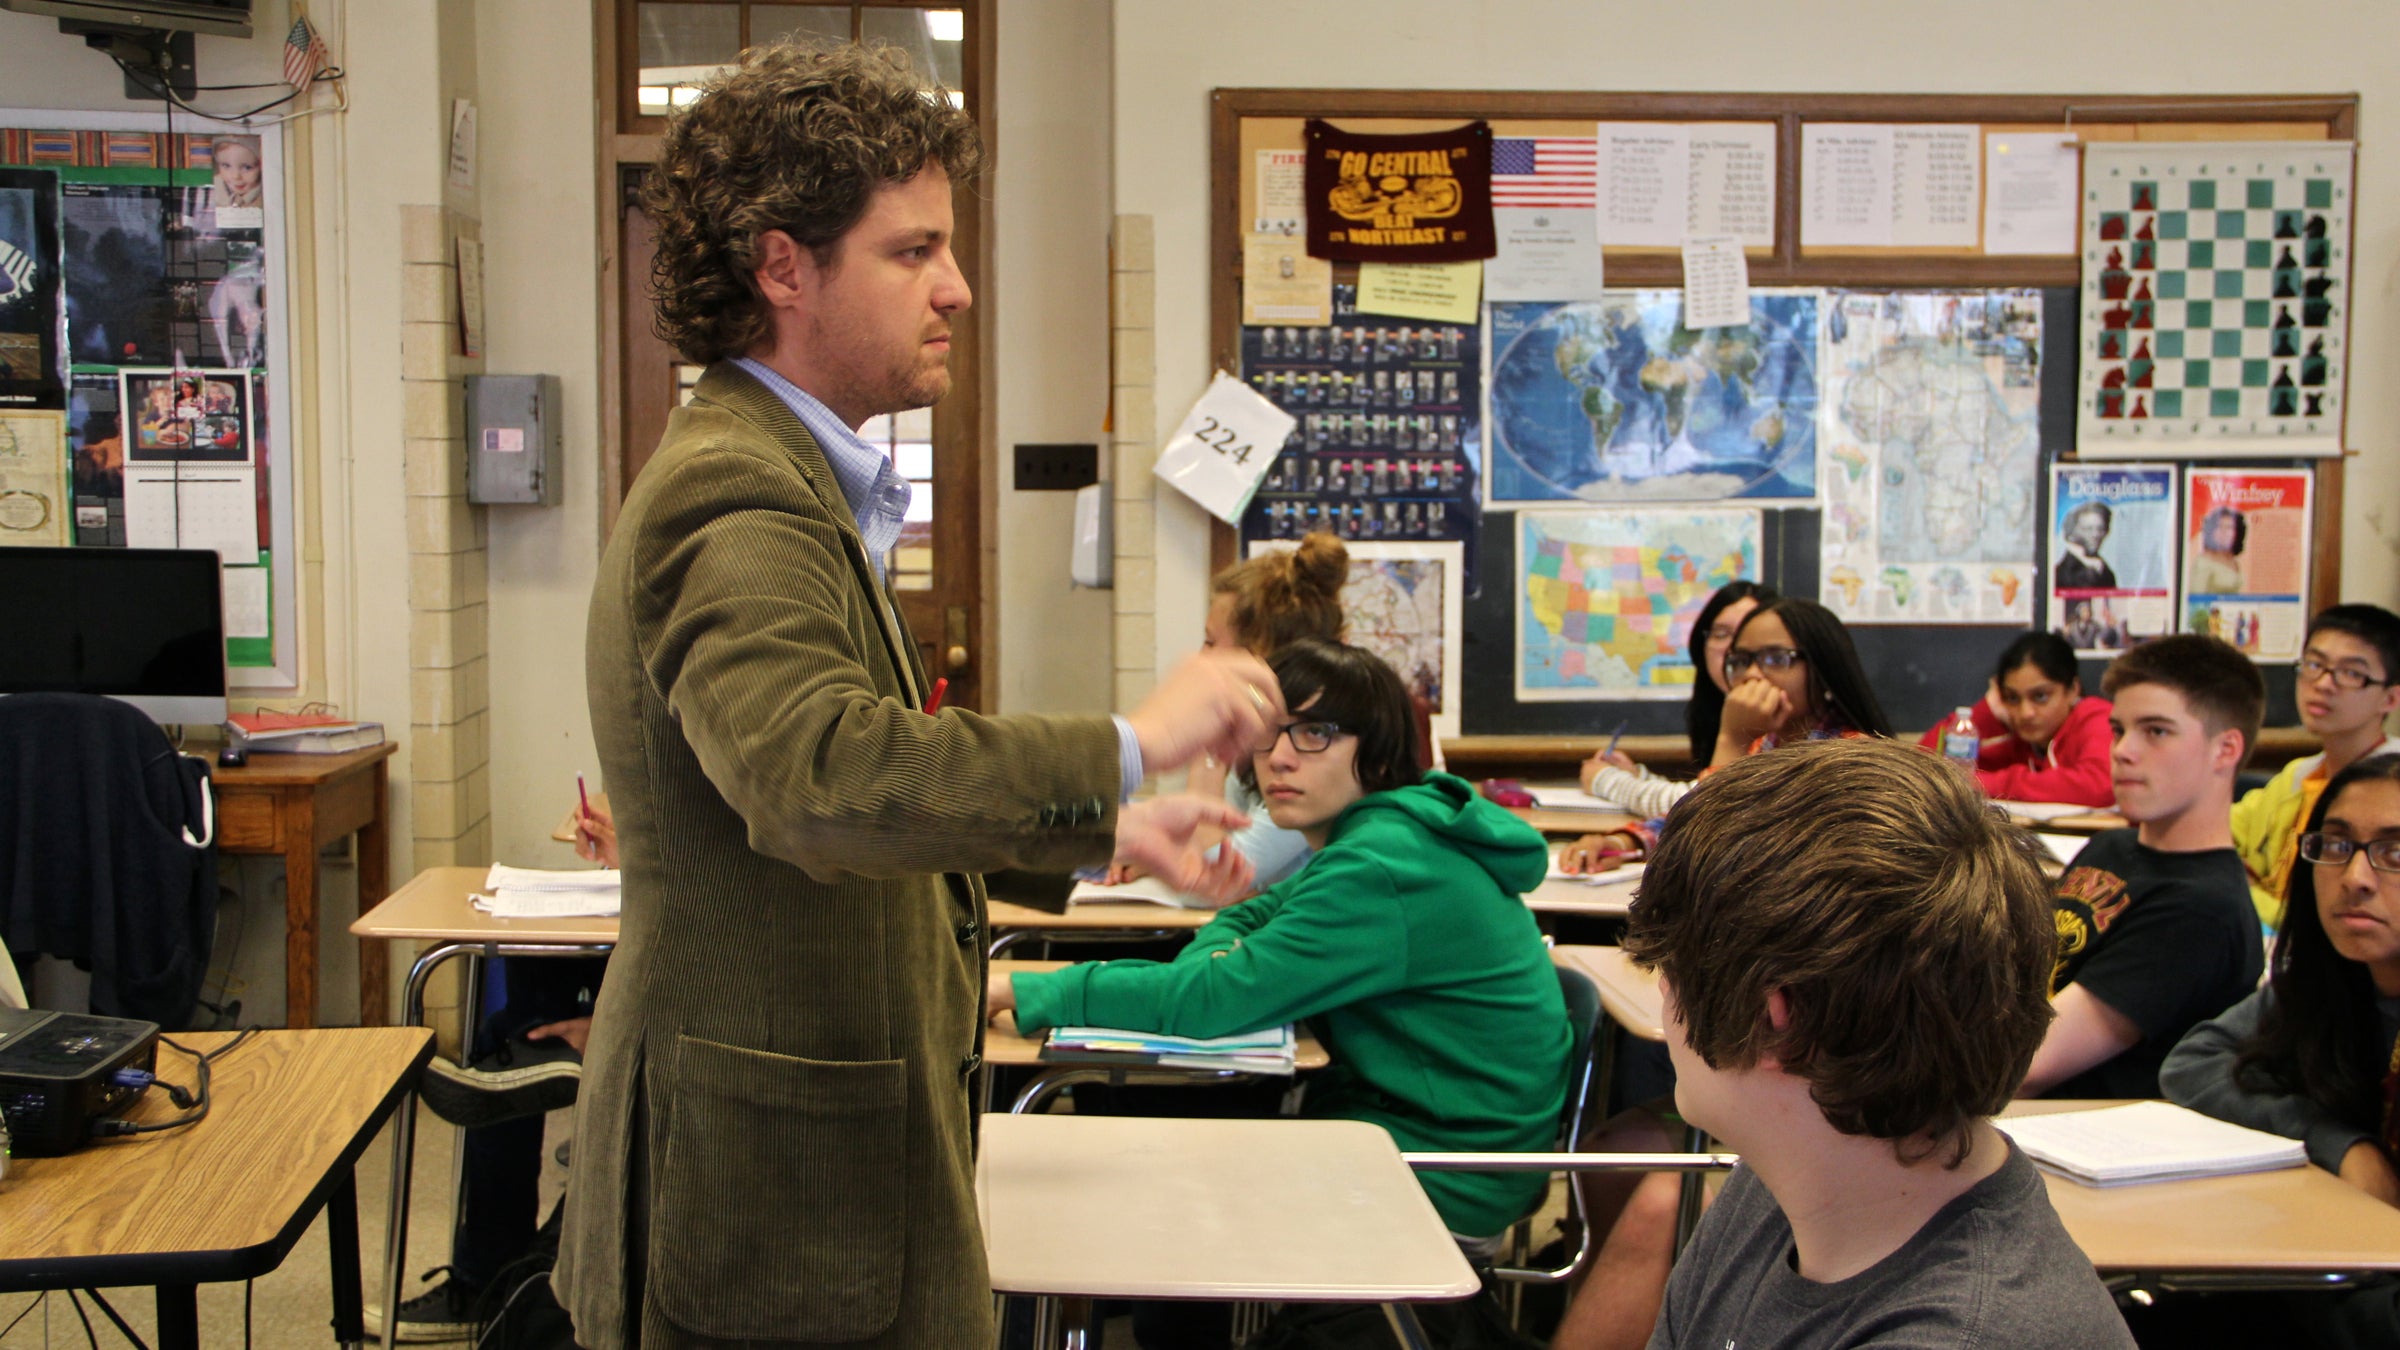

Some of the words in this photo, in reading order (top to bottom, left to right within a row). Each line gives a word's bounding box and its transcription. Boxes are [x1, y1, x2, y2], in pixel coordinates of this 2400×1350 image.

[1339, 152, 1368, 178] GO
[1369, 150, 1453, 177] CENTRAL
[1374, 214, 1414, 228] BEAT
[1348, 227, 1445, 246] NORTHEAST
[1494, 320, 1524, 330] World
[1194, 416, 1252, 466] 224
[2068, 476, 2164, 500] Douglass
[2207, 480, 2286, 507] Winfrey
